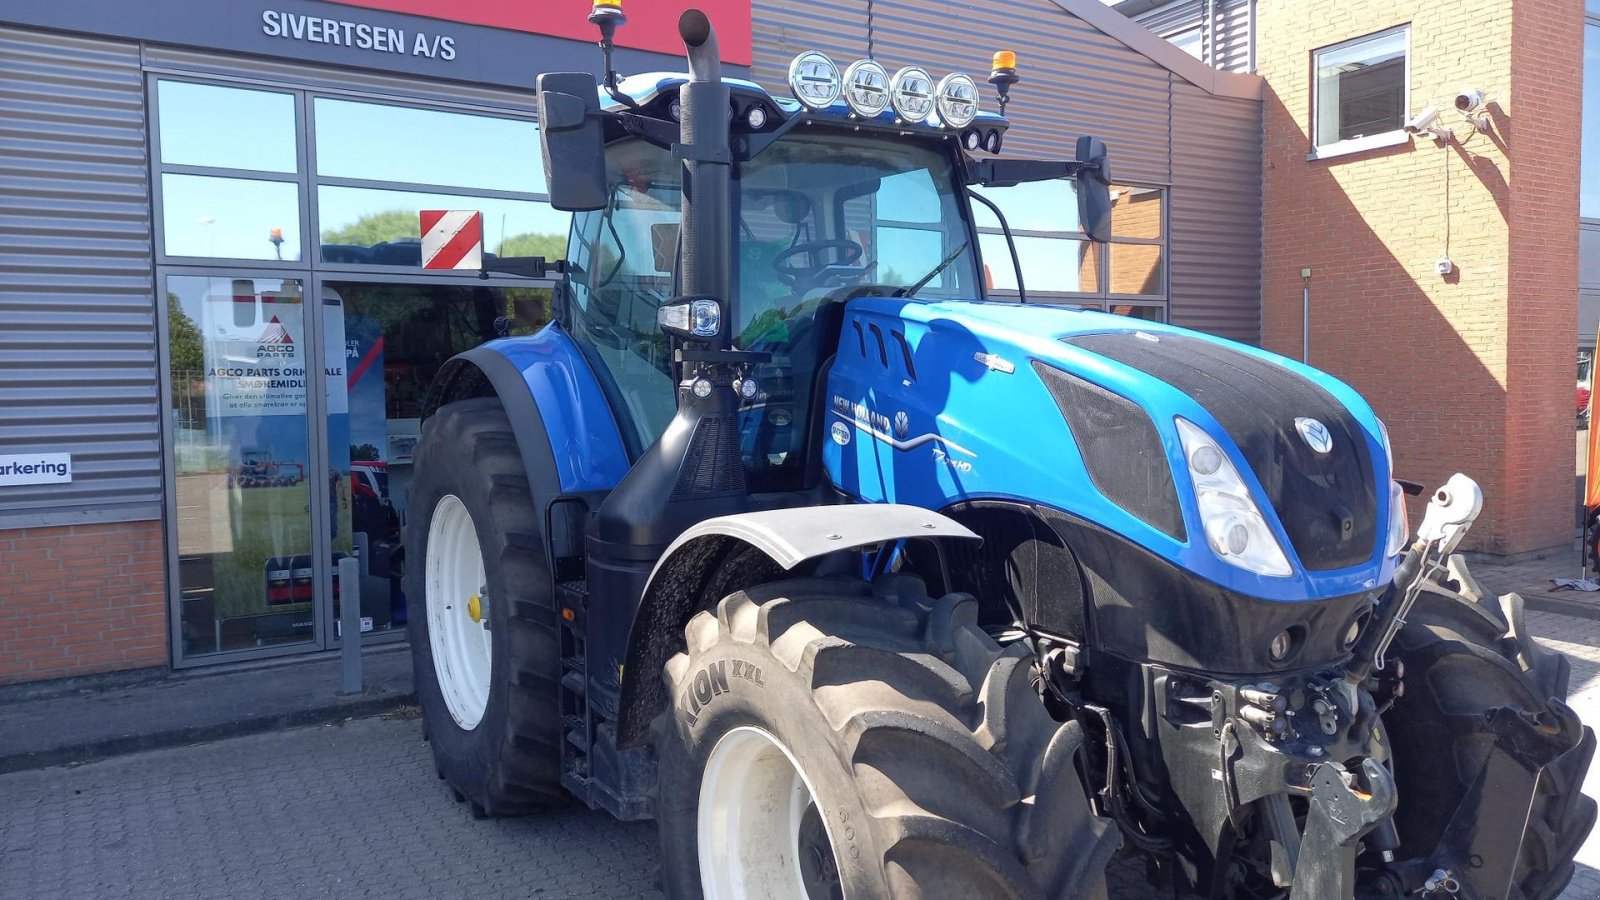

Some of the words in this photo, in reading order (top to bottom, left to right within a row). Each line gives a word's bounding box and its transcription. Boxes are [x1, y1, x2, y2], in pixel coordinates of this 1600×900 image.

[262, 10, 405, 54] SIVERTSEN
[412, 32, 457, 61] A/S
[208, 368, 244, 377] AGCO
[246, 368, 280, 377] PARTS
[731, 659, 765, 688] XXL
